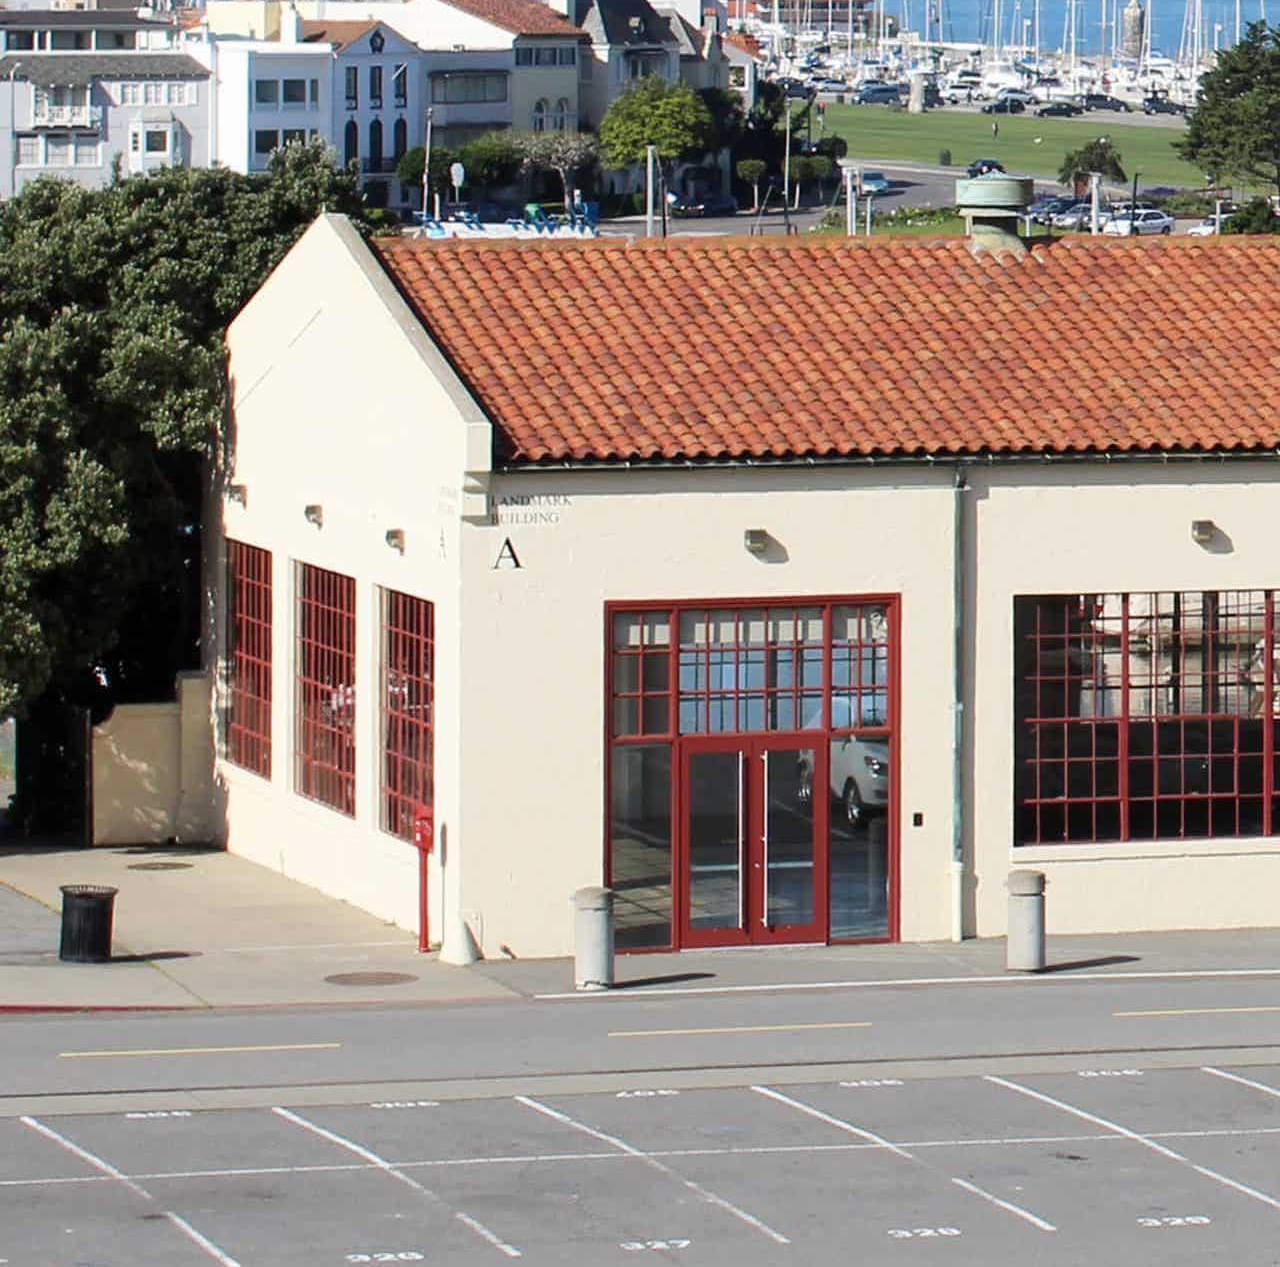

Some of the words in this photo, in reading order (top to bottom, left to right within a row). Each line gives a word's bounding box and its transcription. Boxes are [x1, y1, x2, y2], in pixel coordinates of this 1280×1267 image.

[491, 493, 572, 506] LANDMARK
[491, 512, 559, 525] BUILDING
[492, 536, 523, 568] A
